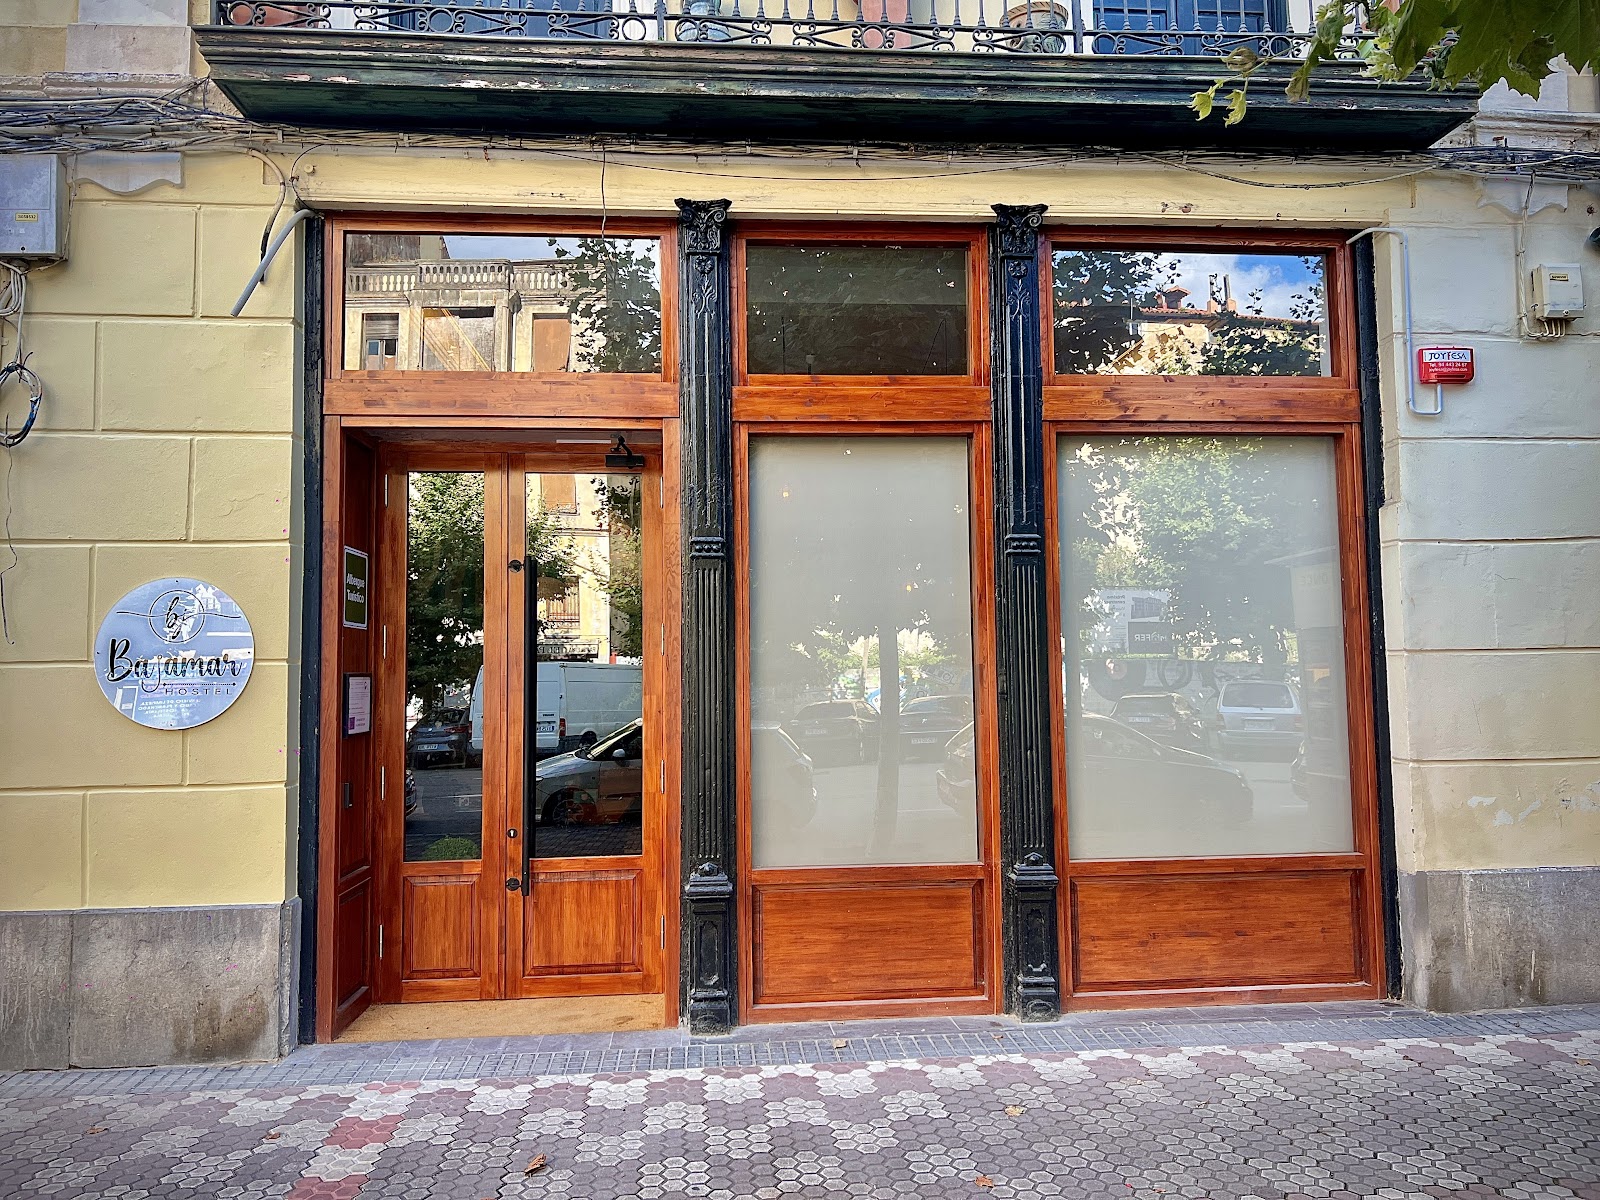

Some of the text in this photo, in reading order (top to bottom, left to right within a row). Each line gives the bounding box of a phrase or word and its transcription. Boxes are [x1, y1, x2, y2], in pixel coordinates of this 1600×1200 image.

[1429, 351, 1467, 361] JOYFESA
[106, 638, 243, 693] Bajamar
[165, 688, 233, 696] HOSTEL
